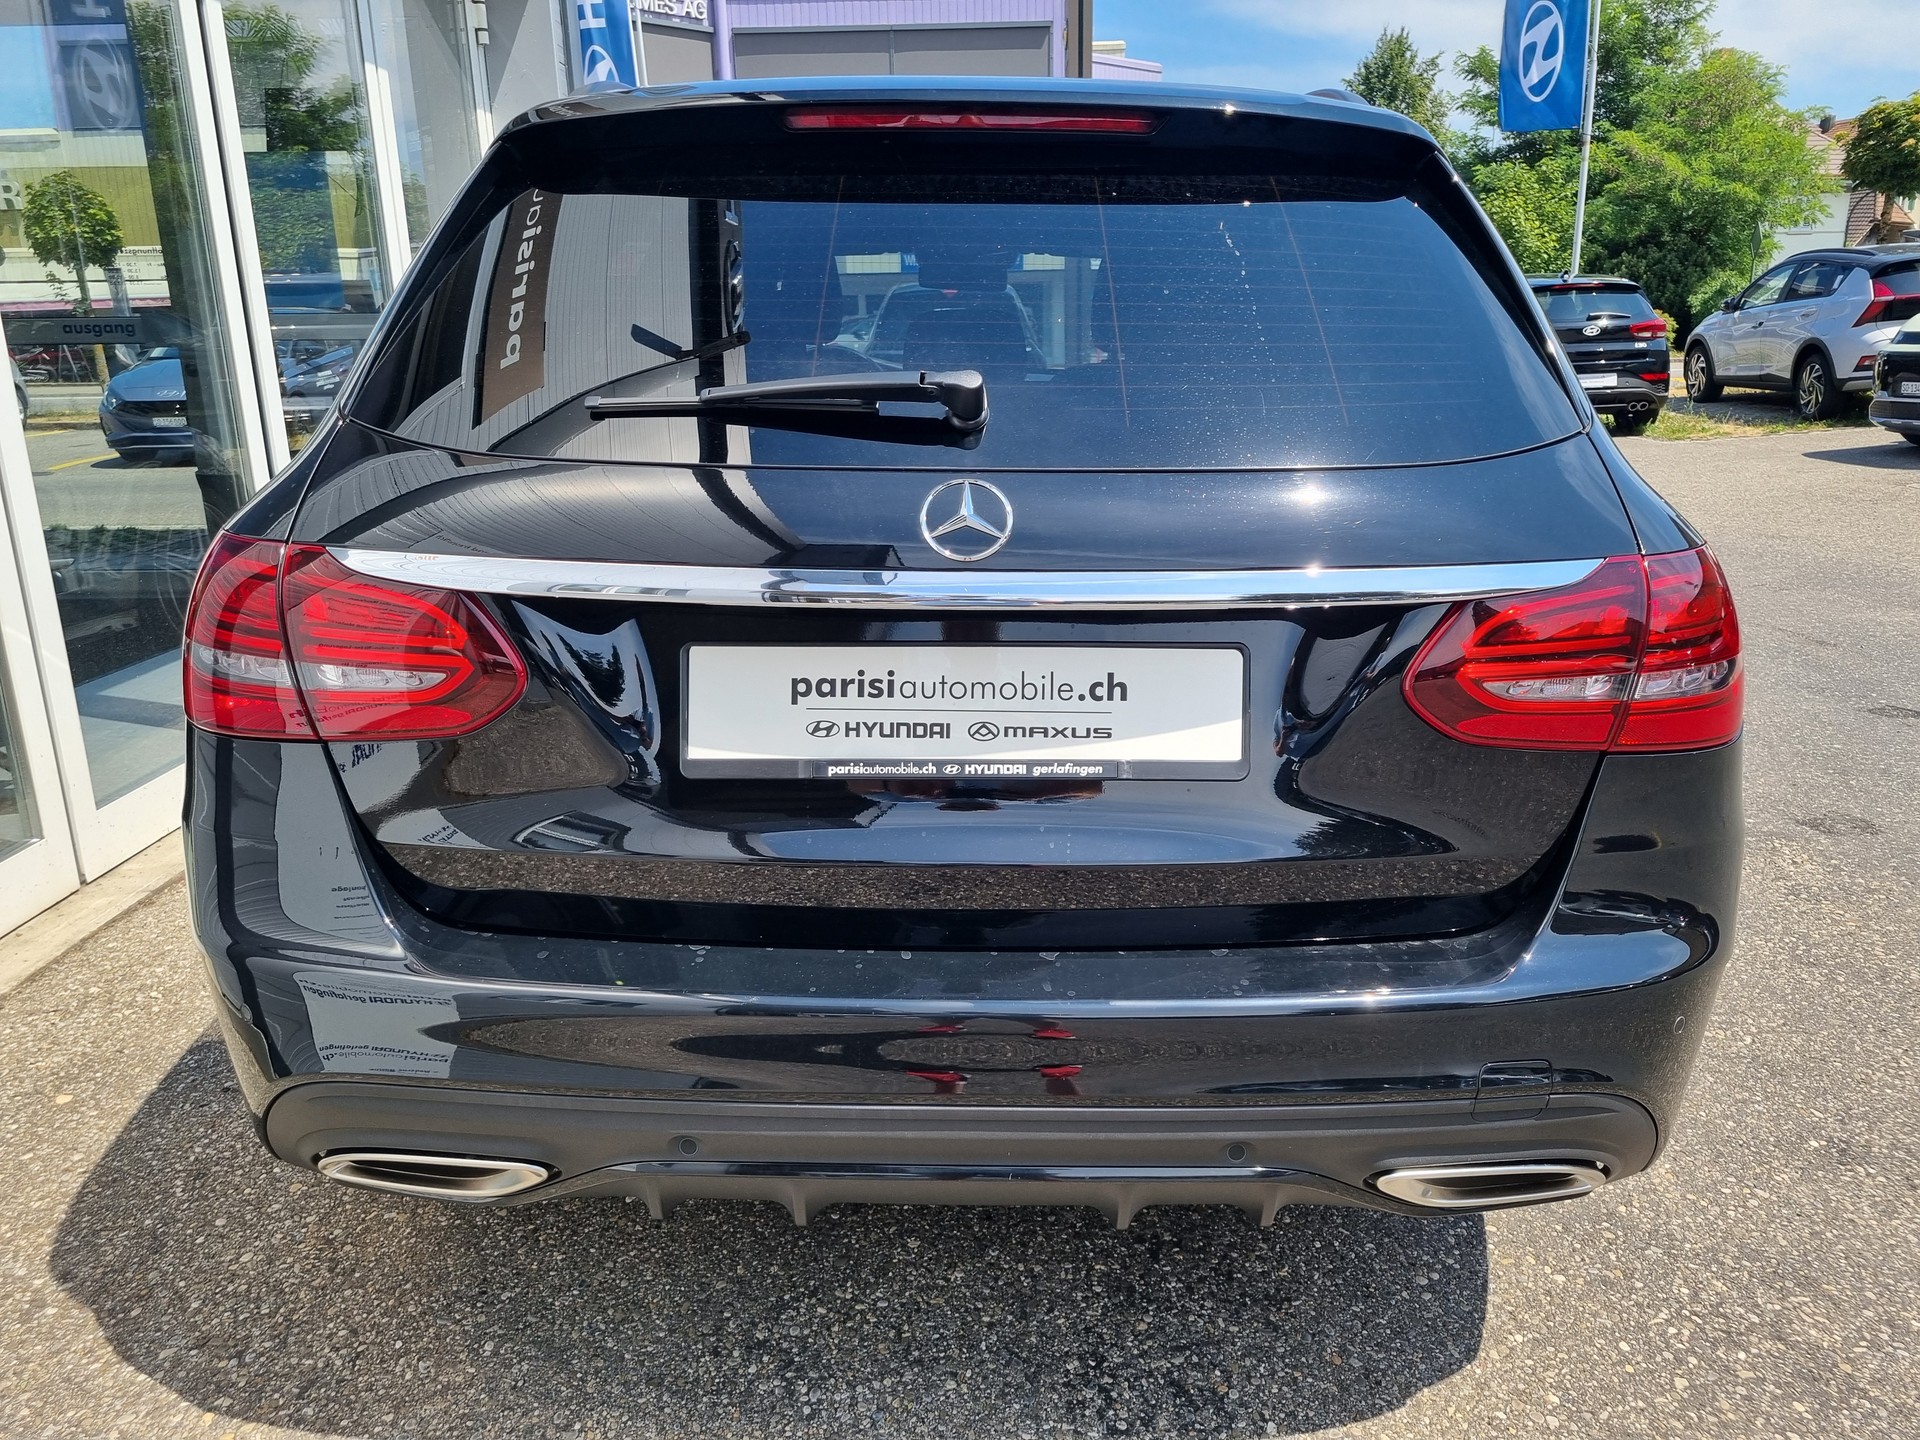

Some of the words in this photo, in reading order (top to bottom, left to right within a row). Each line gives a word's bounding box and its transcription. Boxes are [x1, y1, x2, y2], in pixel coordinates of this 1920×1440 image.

[682, 0, 707, 20] AG
[62, 324, 136, 338] ausgang
[790, 669, 1129, 705] parisiautomobile.ch
[844, 720, 951, 739] HYUNDAI
[1003, 726, 1113, 739] MAXUS
[827, 762, 937, 776] parisiautomobile.ch
[964, 764, 1027, 775] HYUNDAI
[1032, 762, 1104, 776] gerlafingen
